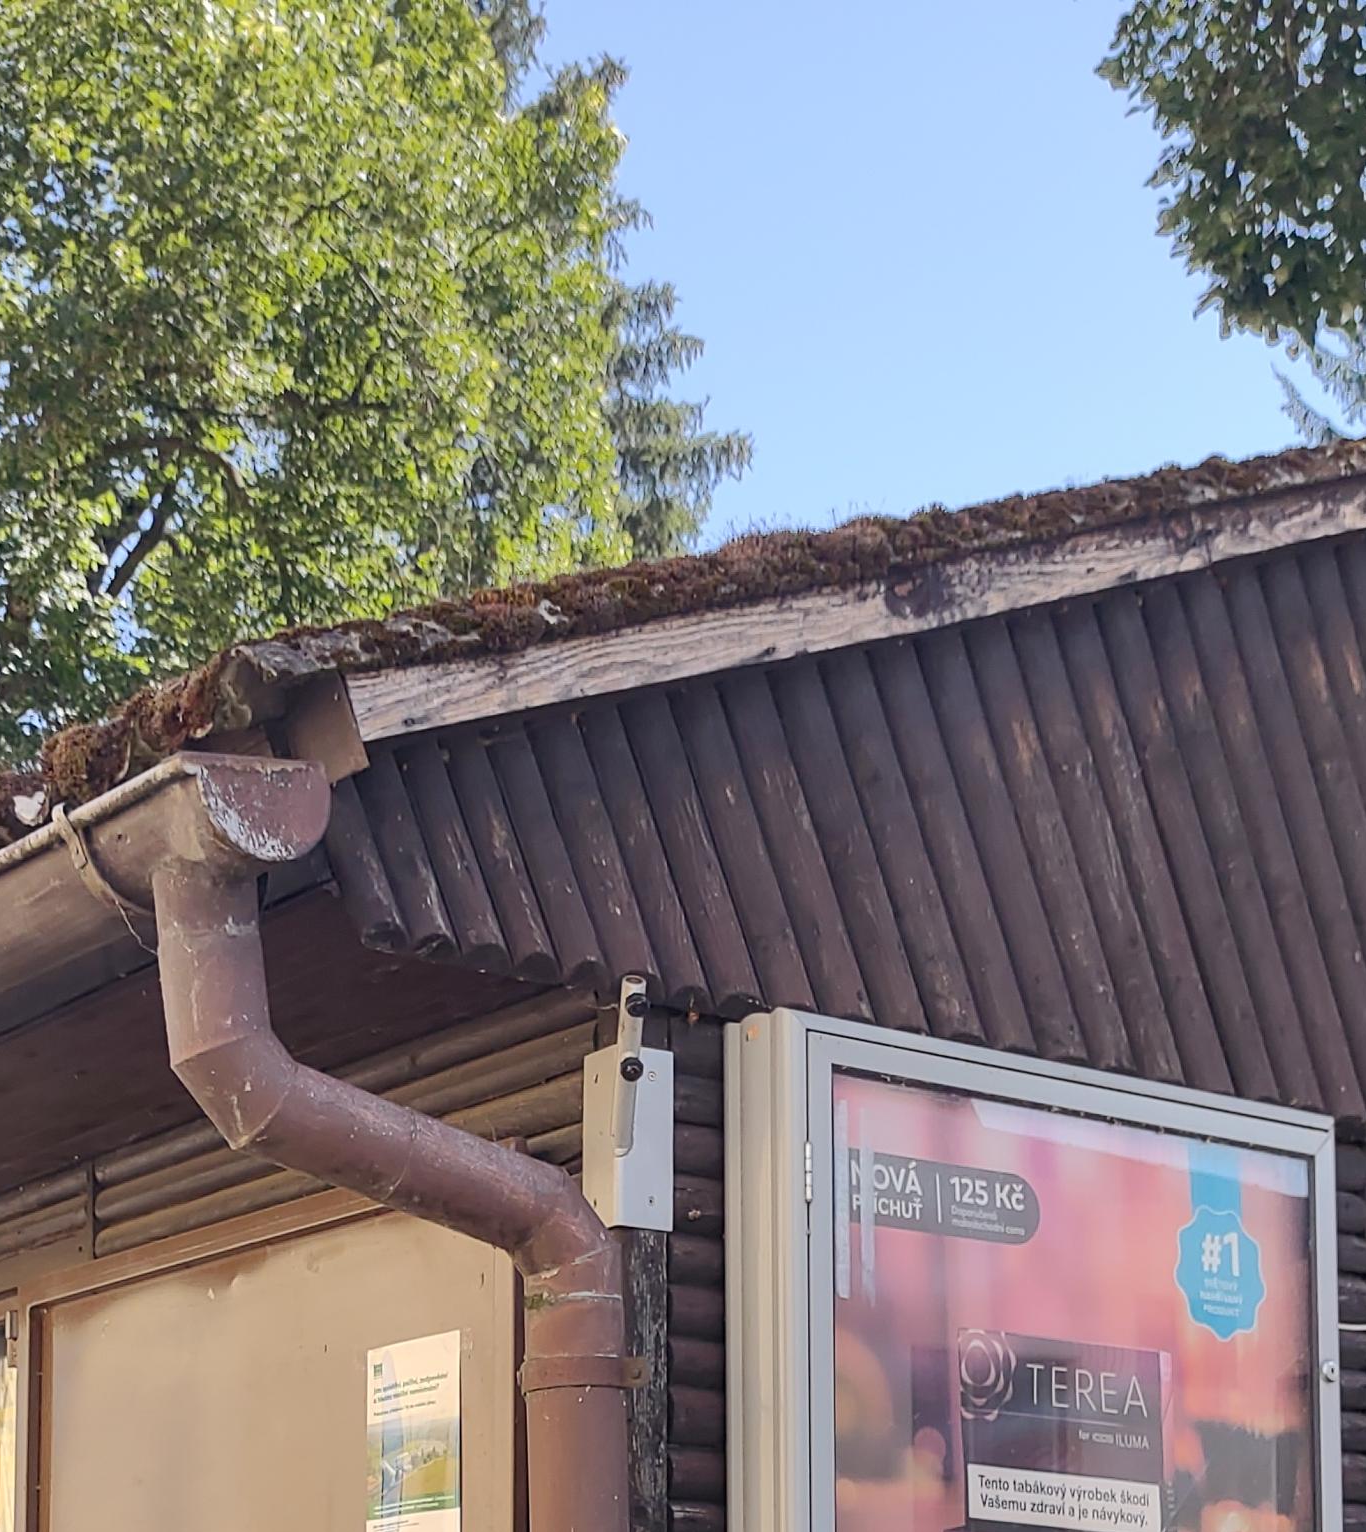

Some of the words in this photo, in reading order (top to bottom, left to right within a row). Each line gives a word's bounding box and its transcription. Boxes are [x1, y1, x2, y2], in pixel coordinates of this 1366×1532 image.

[852, 1193, 923, 1221] PÍCHUŤ
[949, 1175, 989, 1207] 125
[995, 1182, 1026, 1212] Kč
[1201, 1232, 1240, 1277] #1
[1026, 1363, 1148, 1418] TEREA
[1115, 1432, 1150, 1450] ILUMA
[978, 1474, 1010, 1491] Tento
[1013, 1477, 1067, 1500] tabákový
[1070, 1482, 1117, 1504] výrobek
[1120, 1488, 1150, 1508] škodí
[980, 1493, 1027, 1512] Vašemu
[1030, 1499, 1066, 1517] zdraví
[1068, 1506, 1075, 1517] a
[1078, 1503, 1089, 1521] je
